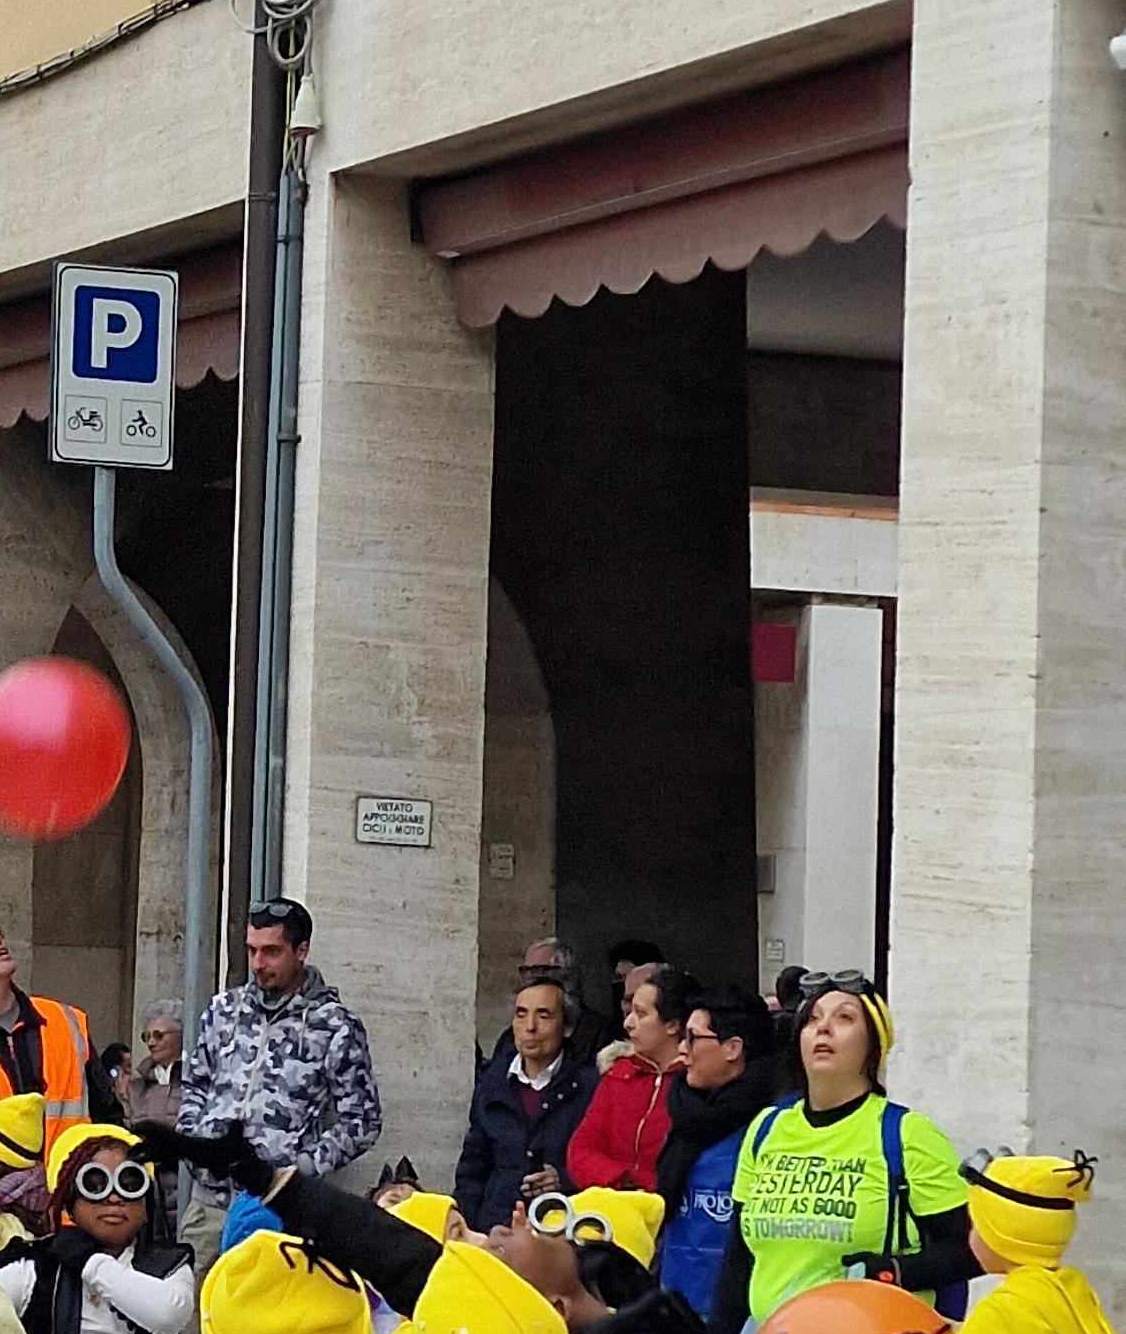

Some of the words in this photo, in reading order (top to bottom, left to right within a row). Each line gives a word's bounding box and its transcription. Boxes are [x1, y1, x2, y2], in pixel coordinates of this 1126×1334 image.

[90, 297, 143, 369] P
[376, 802, 413, 813] VIETATO
[395, 825, 425, 836] MOTO
[759, 1197, 787, 1214] NOT
[789, 1197, 809, 1214] AS
[812, 1197, 857, 1220] GOOD
